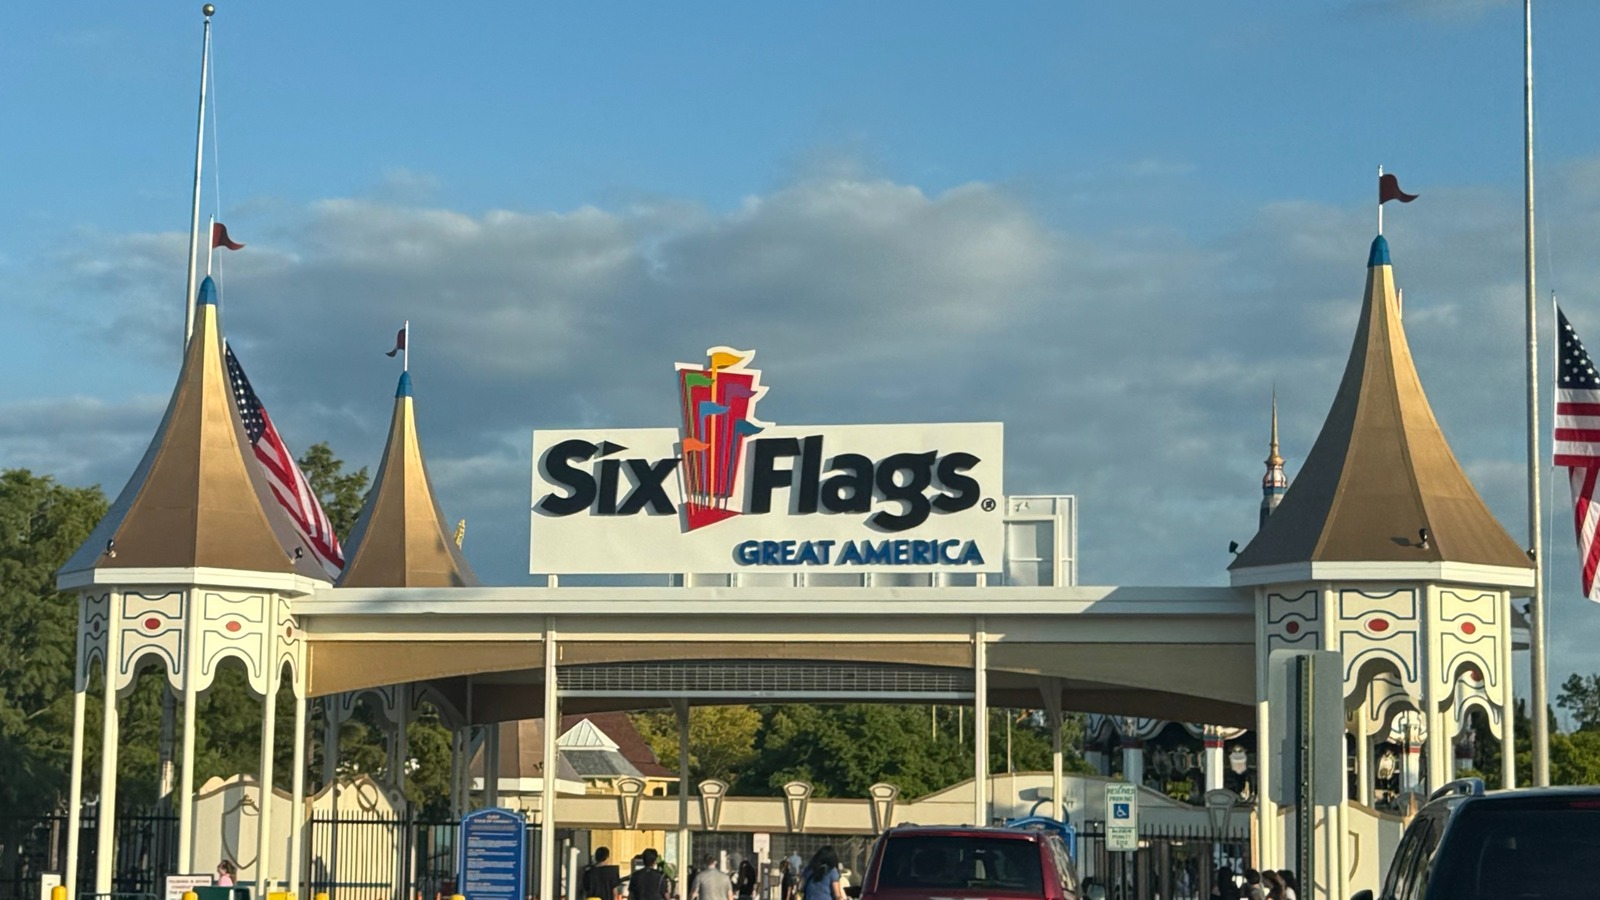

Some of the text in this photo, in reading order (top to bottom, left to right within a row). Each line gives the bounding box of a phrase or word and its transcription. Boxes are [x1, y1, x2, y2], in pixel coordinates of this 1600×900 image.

[534, 434, 981, 532] Six Flags
[733, 539, 985, 566] GREAT AMERICA
